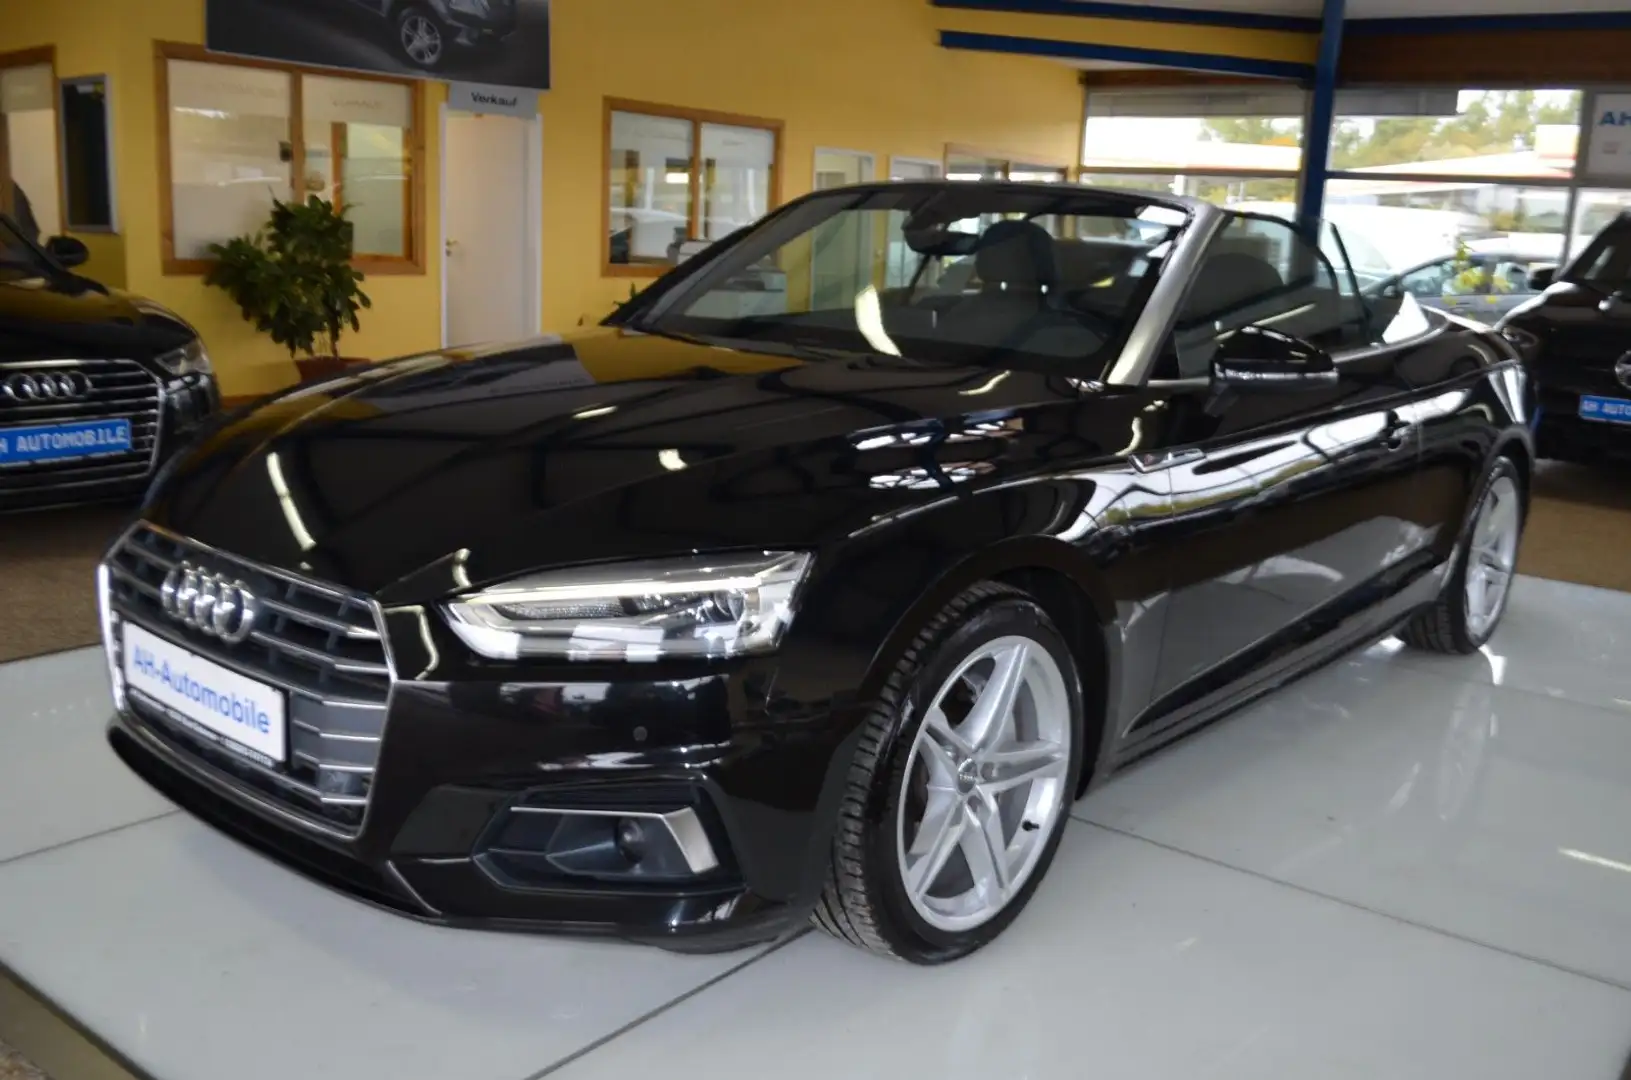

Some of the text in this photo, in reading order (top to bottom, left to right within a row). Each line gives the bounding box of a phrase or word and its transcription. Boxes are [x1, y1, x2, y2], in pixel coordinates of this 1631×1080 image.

[470, 91, 518, 108] Verkauf
[16, 425, 128, 453] AUTOMOBILE
[133, 644, 271, 734] AH-Automobile
